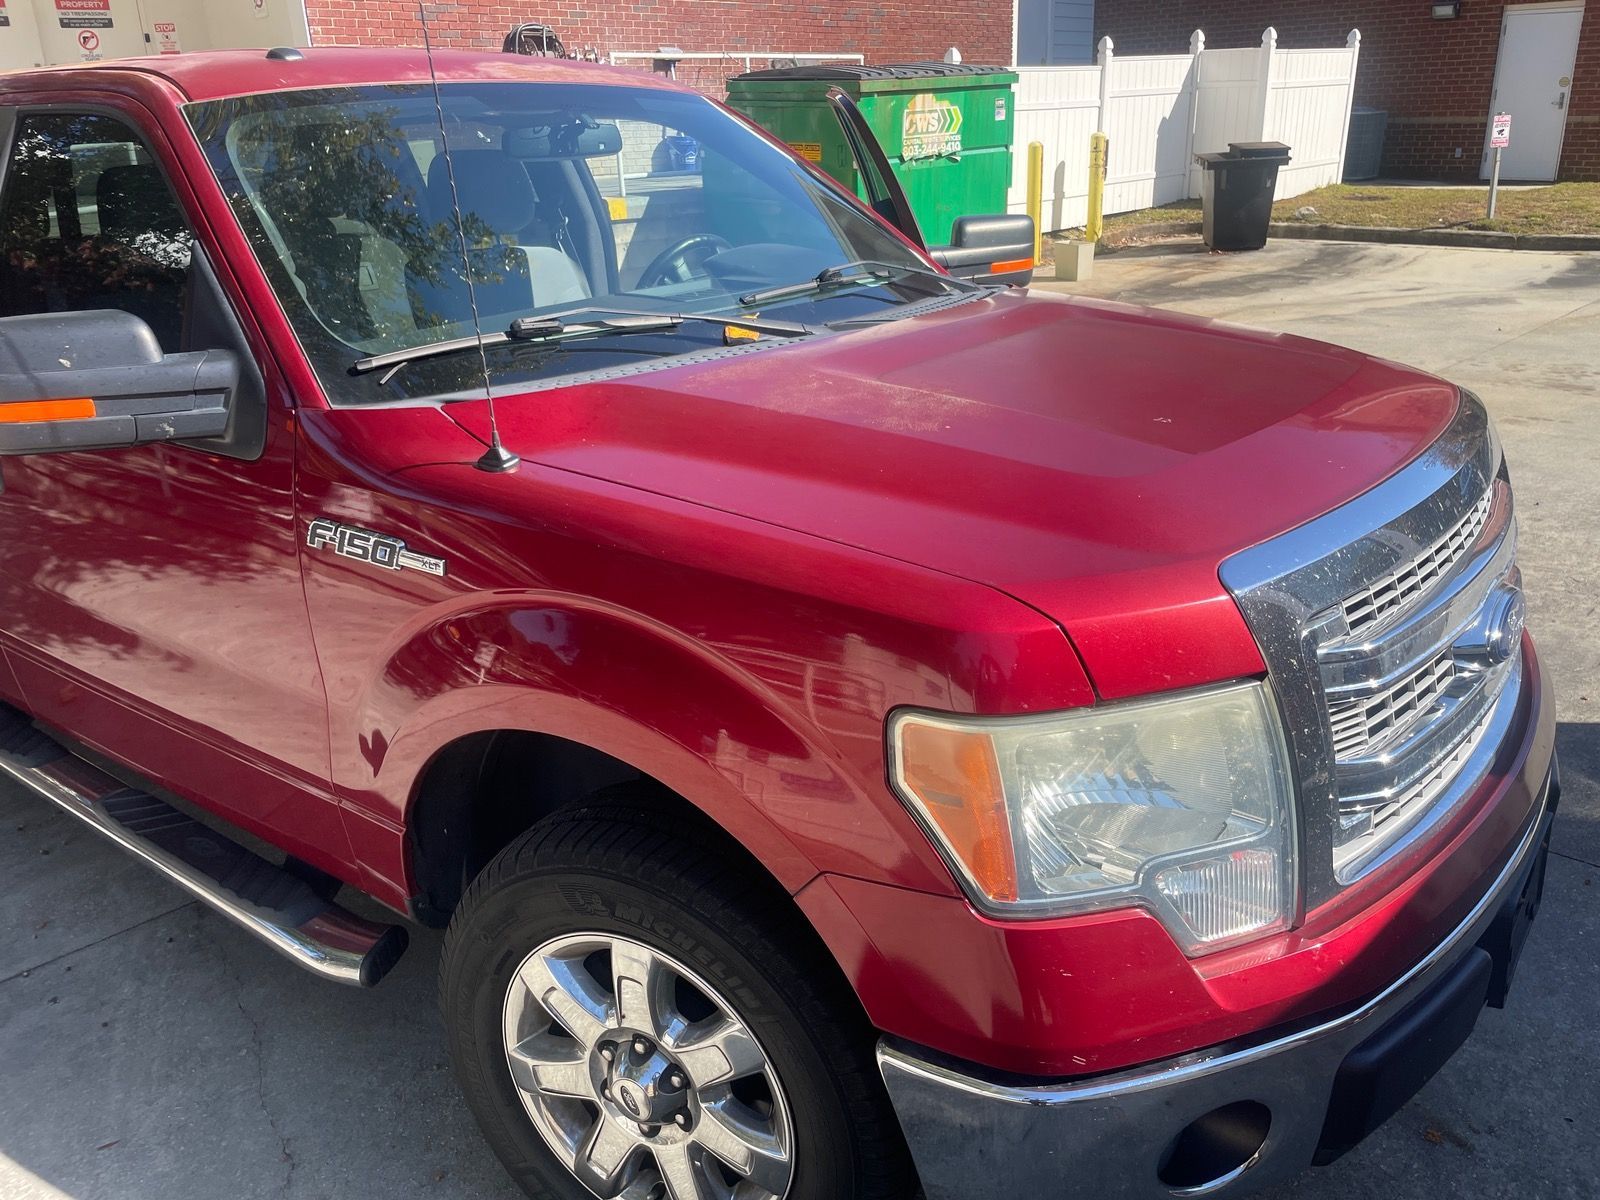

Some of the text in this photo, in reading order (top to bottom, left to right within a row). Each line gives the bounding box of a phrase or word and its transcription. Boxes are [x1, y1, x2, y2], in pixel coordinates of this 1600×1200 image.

[155, 24, 174, 32] STOP
[905, 112, 939, 134] CWS
[306, 520, 441, 571] F-150 XLT
[614, 902, 762, 1008] MICHELIN
